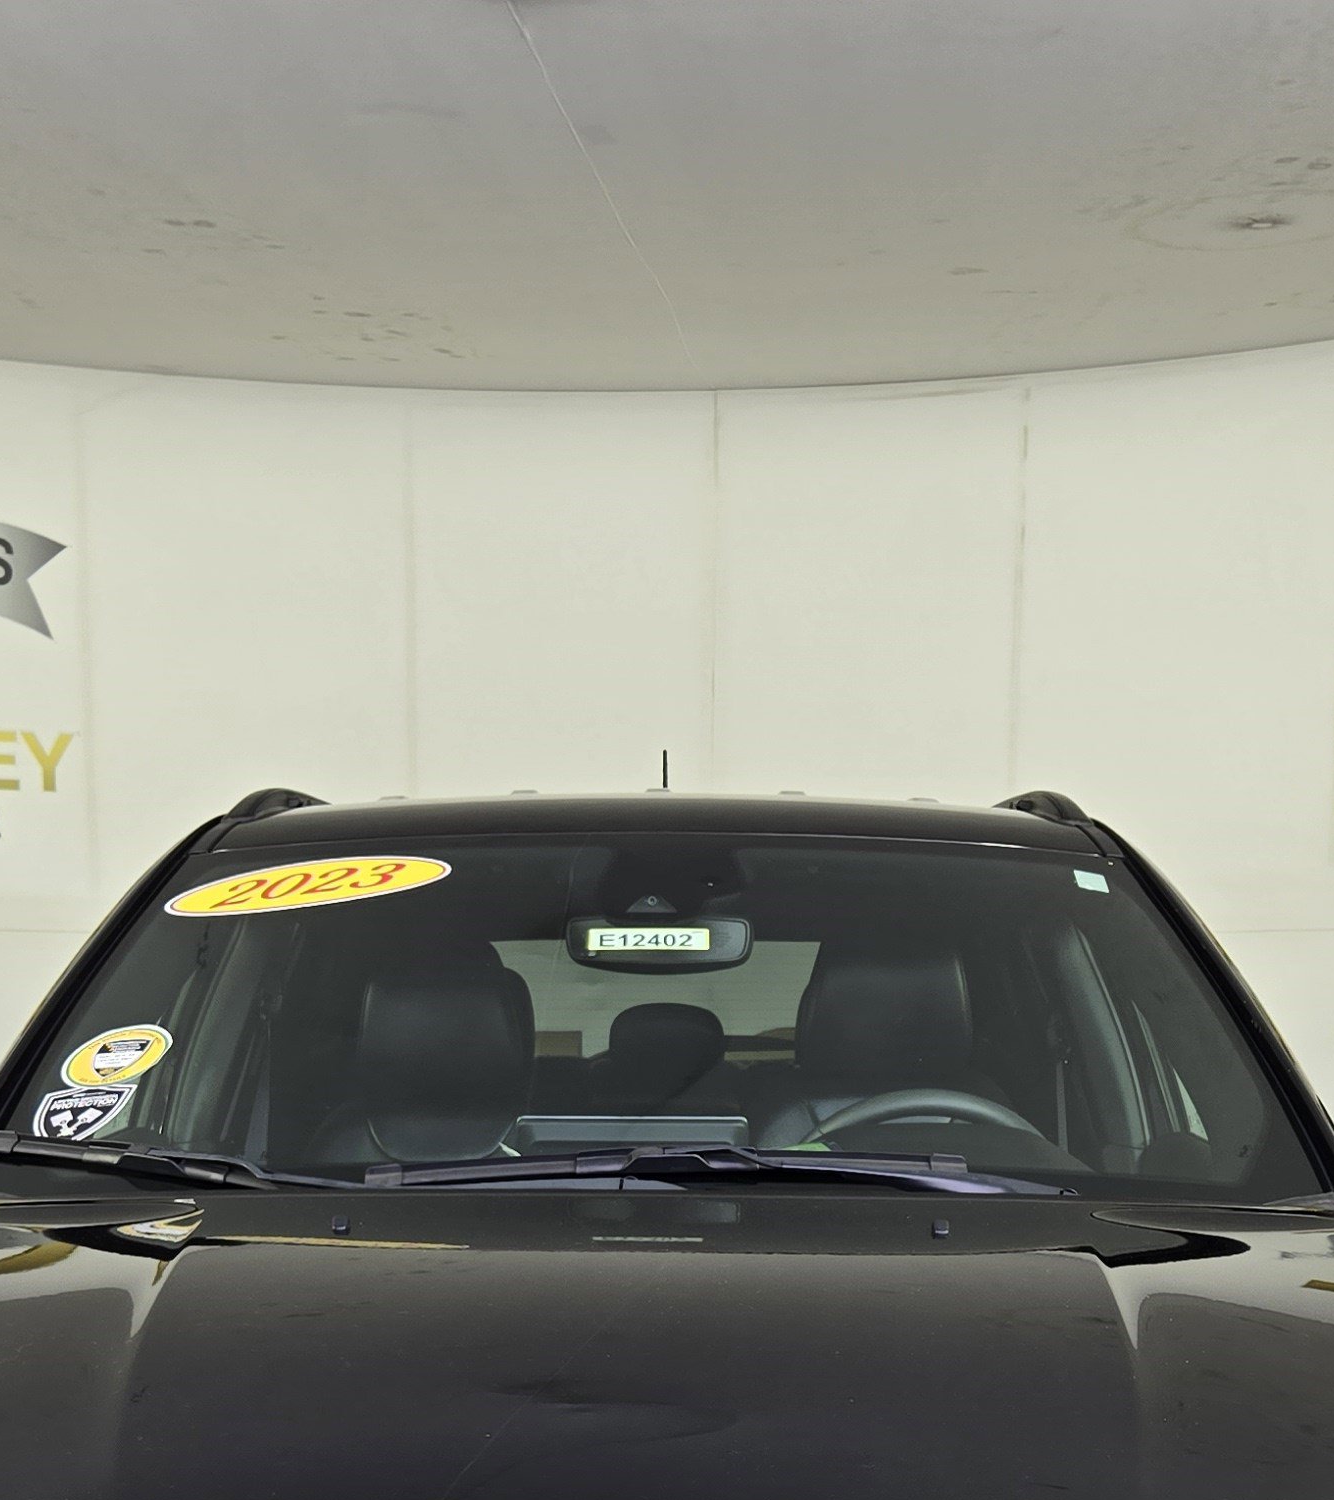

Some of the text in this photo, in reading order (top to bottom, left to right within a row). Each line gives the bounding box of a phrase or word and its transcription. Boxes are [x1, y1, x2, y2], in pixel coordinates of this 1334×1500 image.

[209, 863, 406, 909] 2023
[599, 933, 693, 947] E12402
[49, 1093, 119, 1111] PROTECTION
